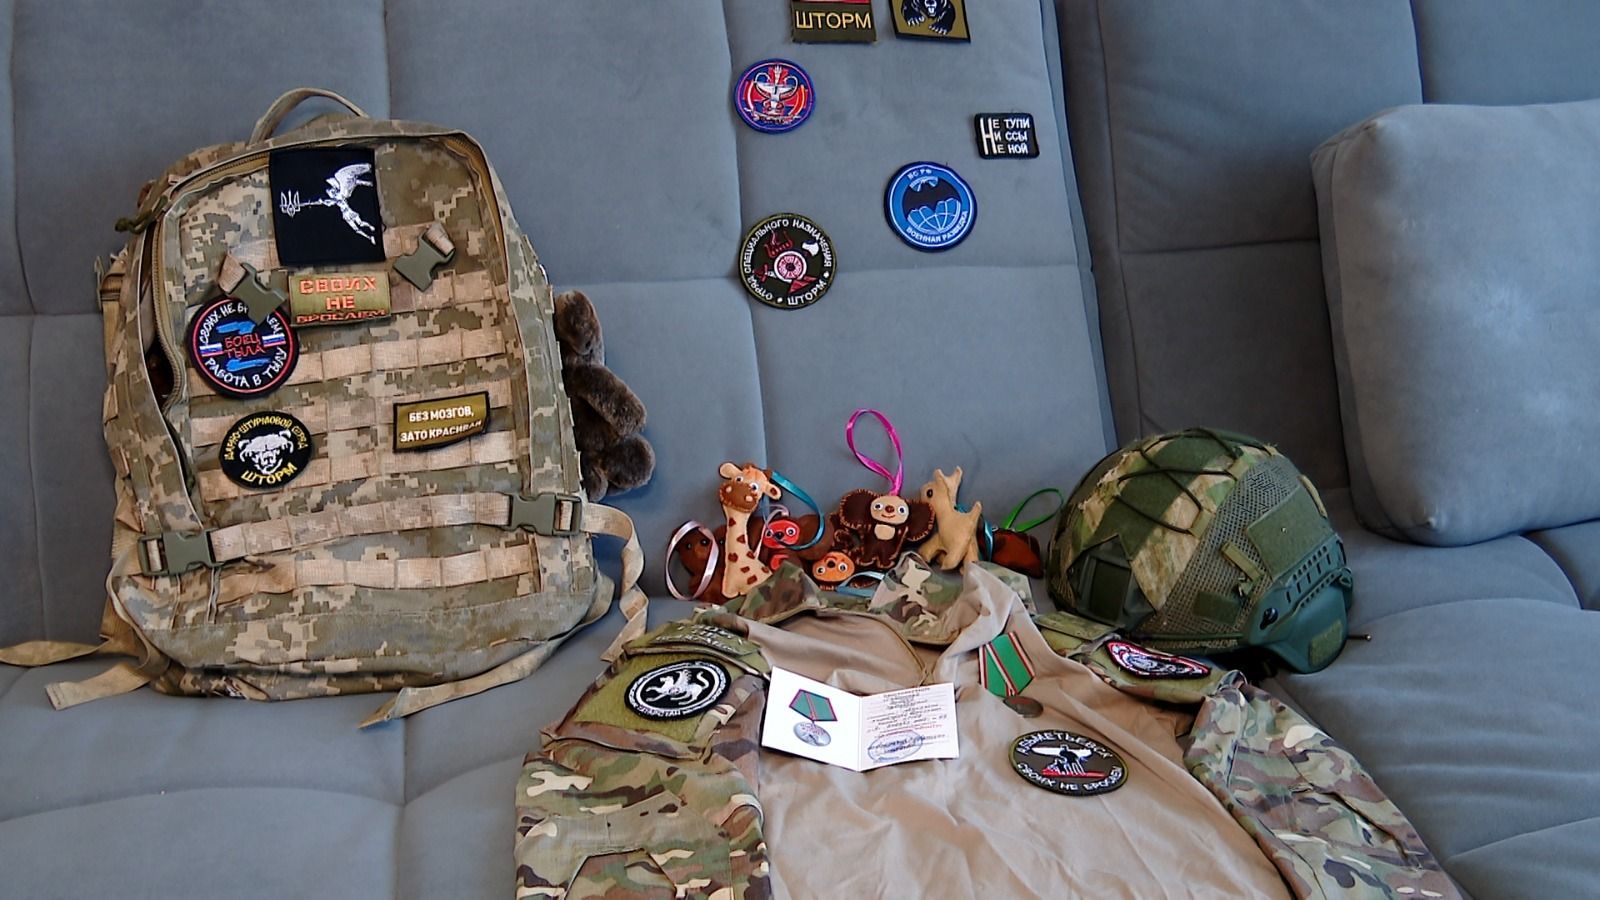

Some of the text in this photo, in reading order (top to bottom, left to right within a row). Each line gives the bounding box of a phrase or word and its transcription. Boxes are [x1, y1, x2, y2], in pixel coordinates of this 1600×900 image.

[795, 10, 872, 30] ШТОРМ
[1003, 118, 1030, 129] ТУПИ
[1005, 131, 1028, 142] ССЫ
[1007, 142, 1029, 154] НОЙ
[743, 218, 790, 274] СПЕЦИАЛЬНОГО
[792, 218, 833, 268] НАЗНАЧЕНИЯ
[299, 276, 377, 294] СВОИХ
[787, 278, 828, 306] ШТОРМ
[219, 302, 237, 317] НЕ
[325, 294, 356, 310] НЕ
[224, 333, 262, 348] БОЕЦ
[205, 346, 288, 389] РАБОТА В ТЫЛУ
[408, 405, 474, 423] БЕЗ МОЗГОВ,
[400, 430, 428, 443] ЗАТО
[241, 461, 298, 486] ШТОРМ
[1060, 782, 1080, 791] НЕ
